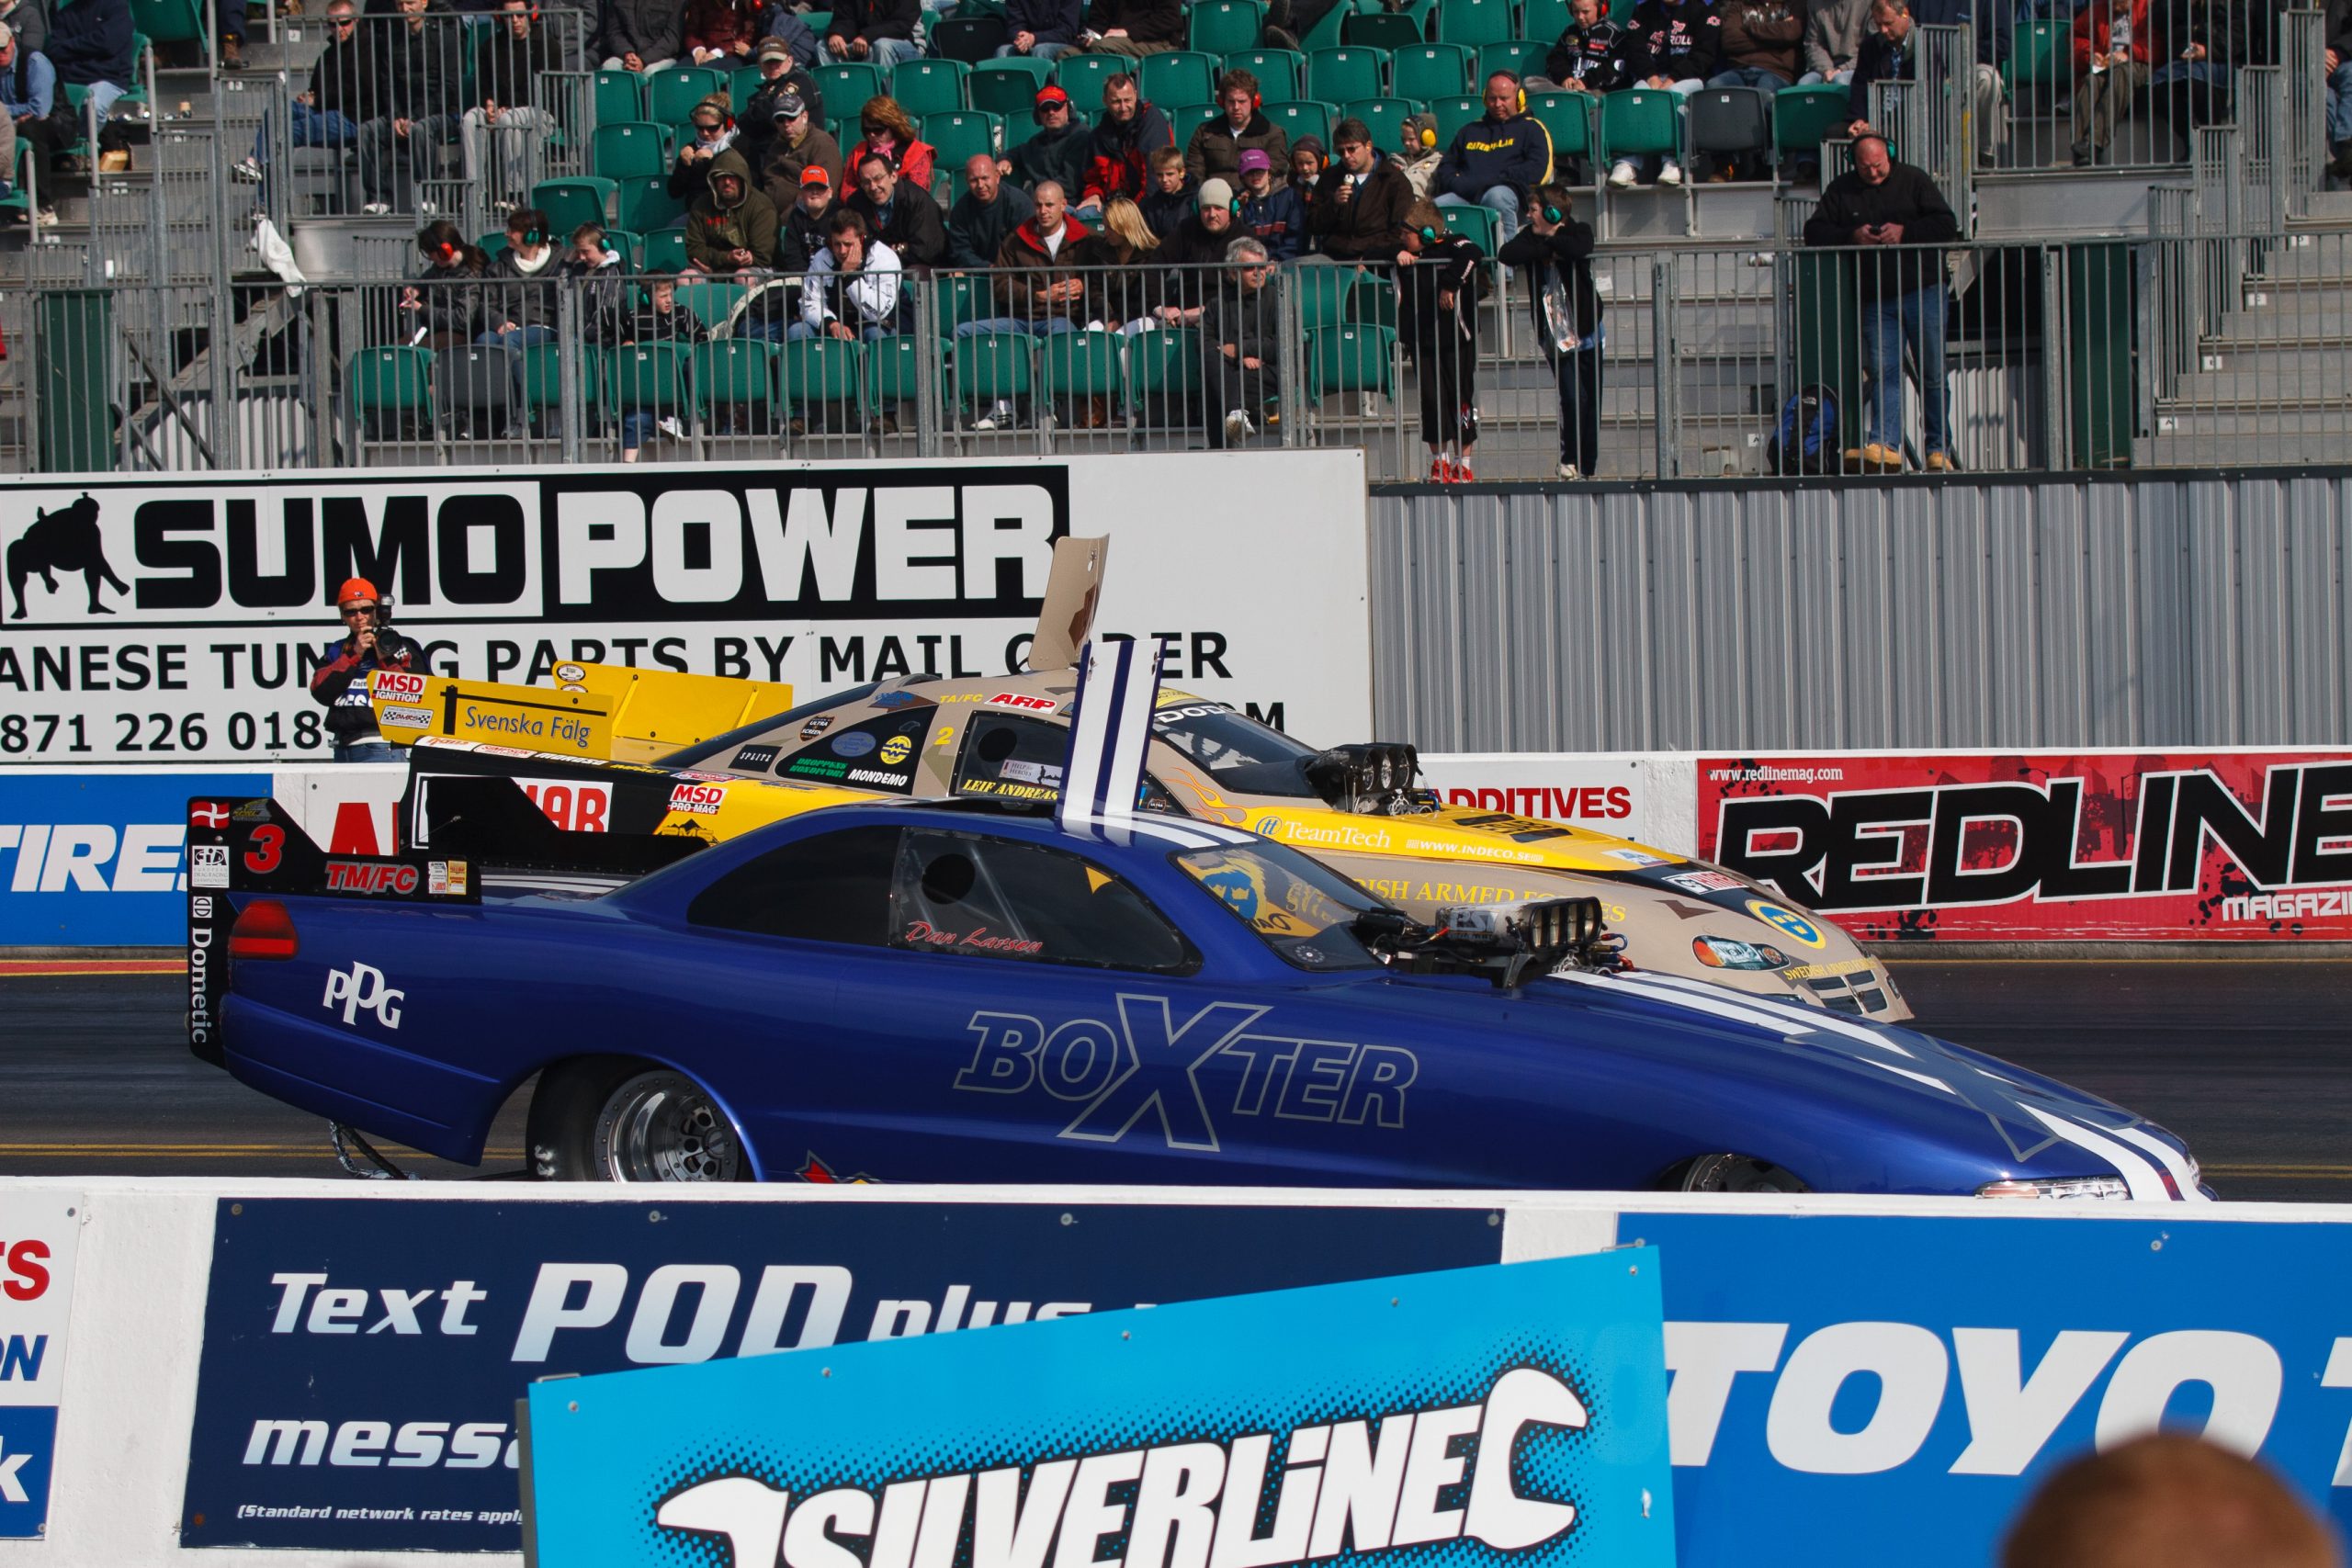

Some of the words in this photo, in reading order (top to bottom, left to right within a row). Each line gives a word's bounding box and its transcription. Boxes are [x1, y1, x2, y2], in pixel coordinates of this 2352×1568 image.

[133, 493, 526, 609] SUMO
[558, 483, 1056, 605] POWER
[0, 644, 187, 692] ANESE
[209, 637, 460, 690] TUNG
[715, 636, 795, 682] BY
[820, 633, 981, 682] MAIL
[1005, 631, 1233, 679] OER
[375, 691, 420, 704] IGNITION
[377, 673, 424, 694] MSD
[939, 694, 984, 704] TA/FC
[989, 693, 1057, 710] ARP
[0, 714, 92, 753] 871
[116, 712, 209, 751] 226
[465, 705, 544, 736] Svenska
[550, 716, 592, 749] Fälg
[933, 727, 955, 745] 2
[847, 768, 909, 786] MONDEMO
[962, 779, 993, 793] LEIF
[1709, 765, 1844, 784] www.redlinemag.com
[672, 784, 723, 805] MSD
[693, 804, 717, 815] MAG
[244, 824, 286, 874] 3
[1284, 819, 1391, 849] TeamTech
[0, 824, 187, 892] IRE
[1419, 839, 1532, 862] WWW.INDECO.SE
[325, 861, 419, 895] TM/FC
[1415, 882, 1515, 904] ARMED
[2222, 891, 2352, 921] MAGAZI
[905, 920, 957, 944] Dan
[959, 927, 1044, 954] Larsen
[191, 927, 212, 1043] Dometic
[952, 992, 1419, 1152] BOXTER
[271, 1273, 489, 1336] Text
[510, 1263, 853, 1364] POD
[1663, 1321, 2283, 1474] TOYO
[242, 1419, 520, 1469] mess
[336, 1506, 414, 1520] network
[421, 1507, 473, 1521] rates
